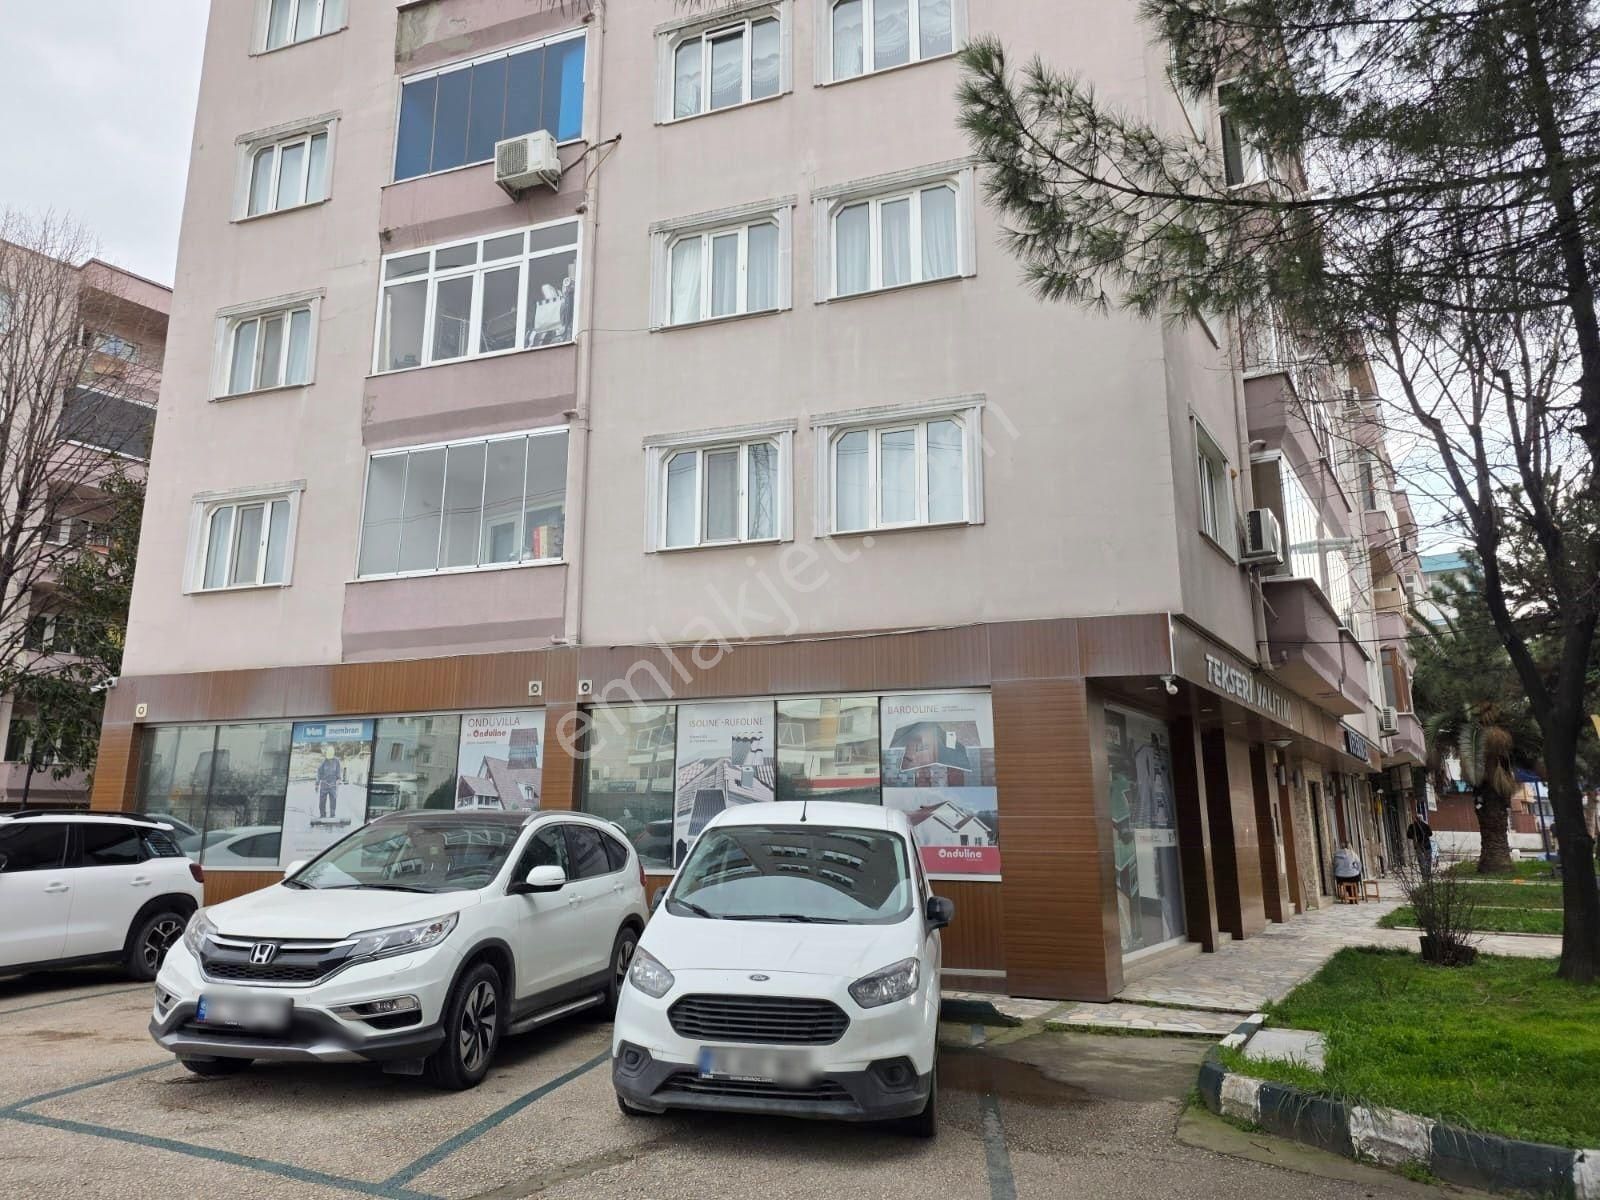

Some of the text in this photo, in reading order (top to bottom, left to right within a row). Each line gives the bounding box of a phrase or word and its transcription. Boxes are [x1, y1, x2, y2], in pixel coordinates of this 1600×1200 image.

[887, 704, 940, 715] BARDOLINE
[467, 716, 521, 728] ONDUVILLA
[472, 729, 507, 738] Onduline
[938, 848, 983, 859] Onduline
